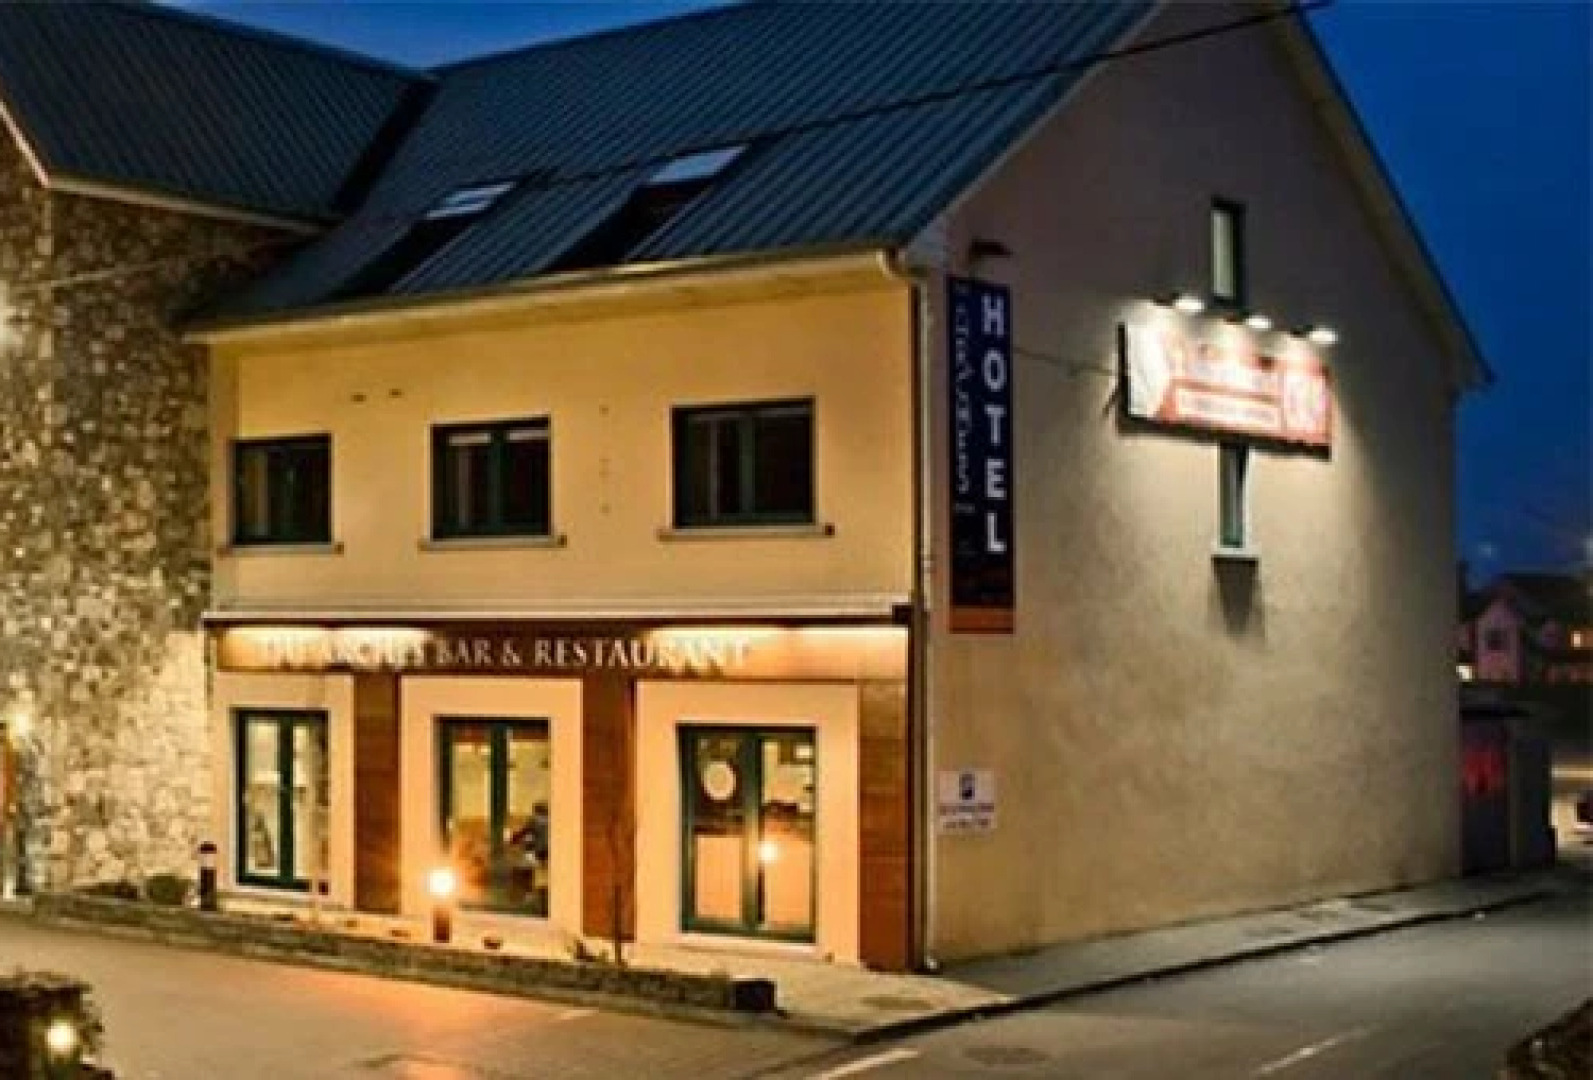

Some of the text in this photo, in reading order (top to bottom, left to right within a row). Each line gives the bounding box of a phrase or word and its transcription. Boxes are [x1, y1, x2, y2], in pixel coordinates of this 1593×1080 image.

[982, 293, 1007, 553] HOTEL
[435, 636, 493, 666] BAR
[502, 637, 524, 666] &
[534, 636, 747, 670] RESTAURANT
